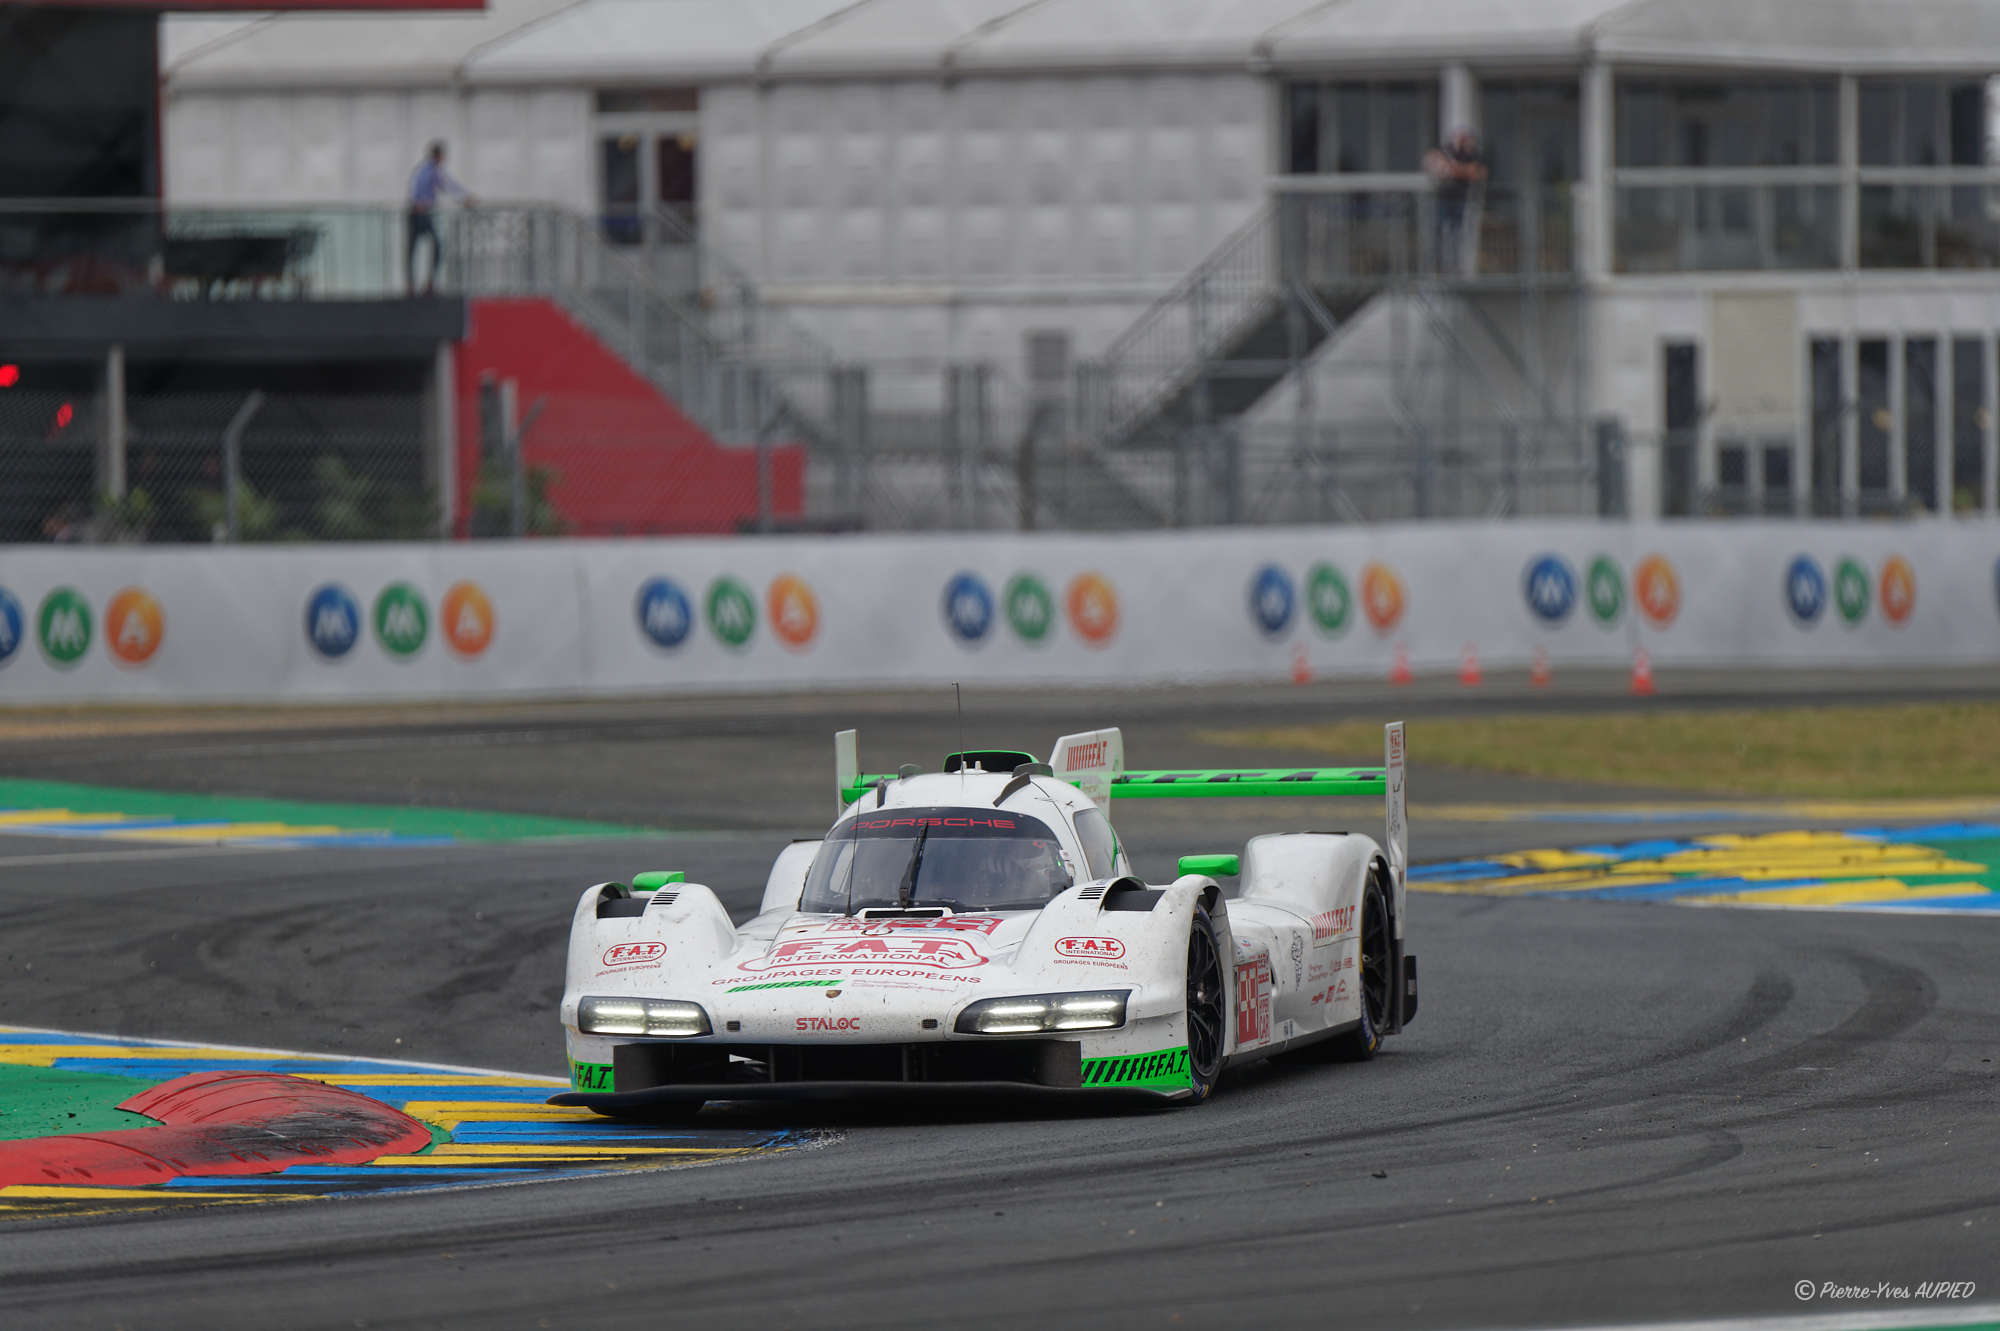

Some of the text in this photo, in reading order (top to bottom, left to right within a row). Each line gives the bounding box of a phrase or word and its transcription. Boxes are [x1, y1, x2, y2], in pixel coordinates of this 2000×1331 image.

[851, 818, 1017, 831] PORSCHE
[769, 952, 951, 966] INTERNATIONAL
[1065, 949, 1118, 957] INTERNATIONAL
[712, 968, 842, 985] GROUPAGES
[796, 1017, 860, 1030] STALOC
